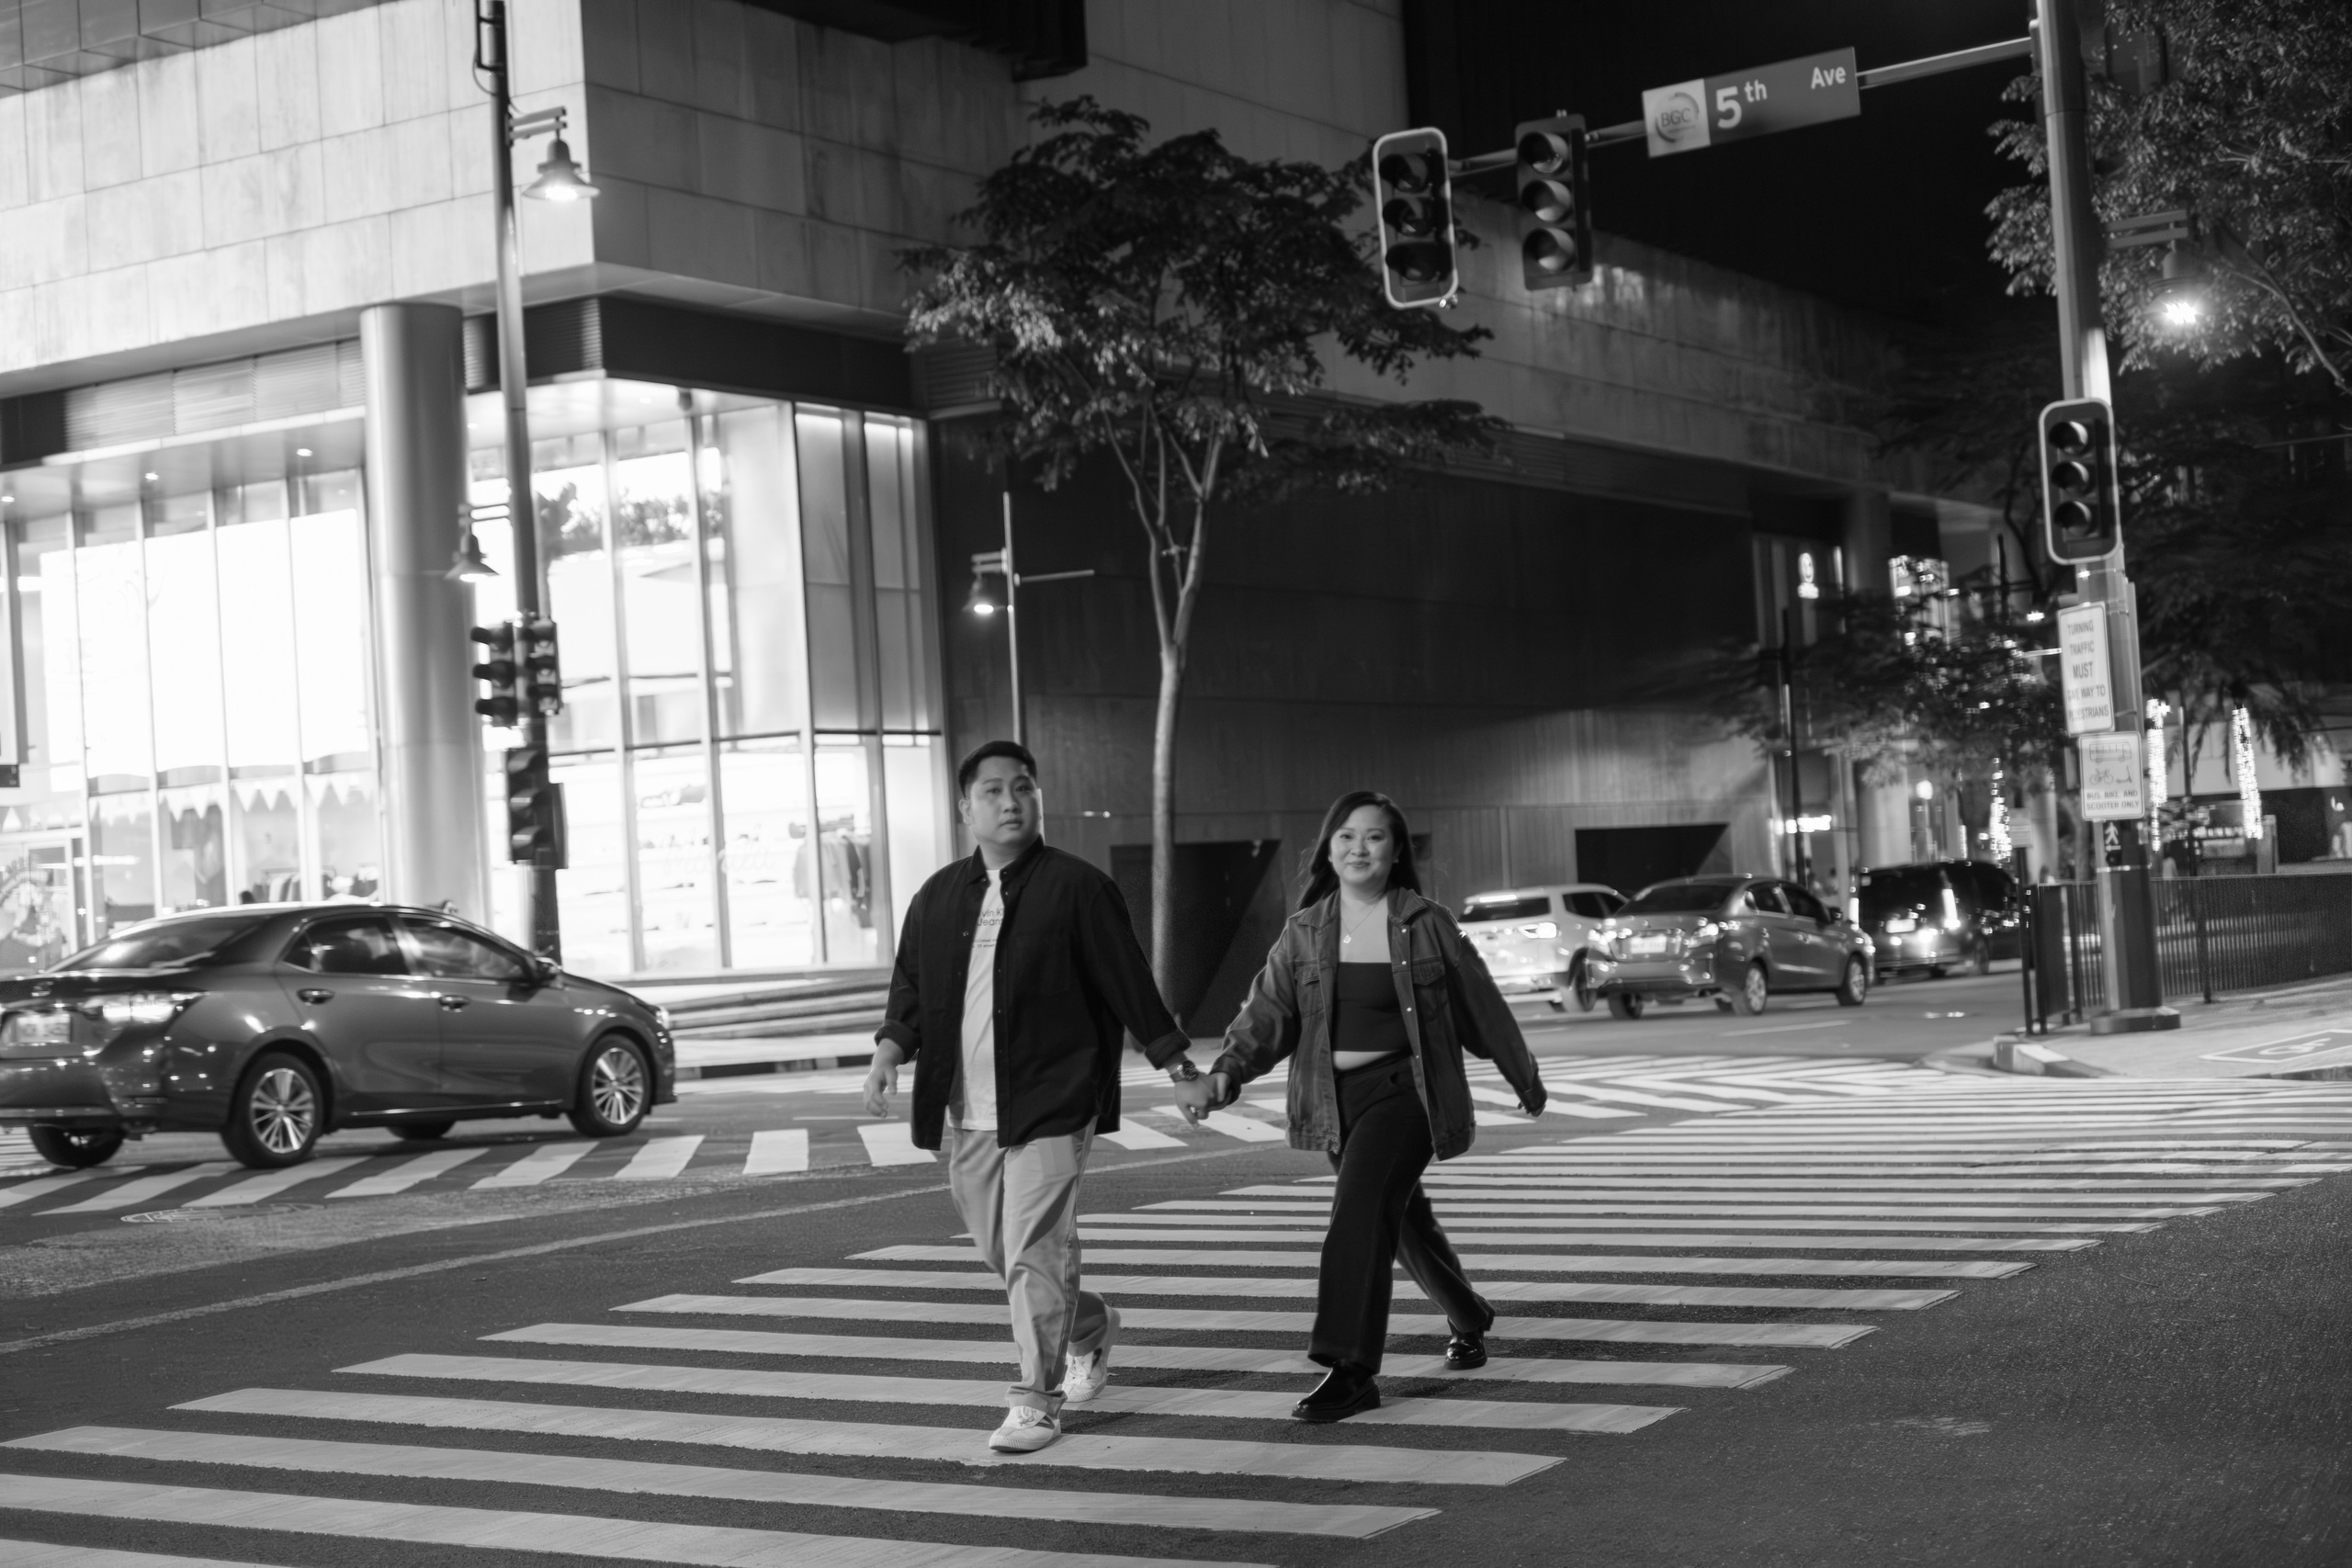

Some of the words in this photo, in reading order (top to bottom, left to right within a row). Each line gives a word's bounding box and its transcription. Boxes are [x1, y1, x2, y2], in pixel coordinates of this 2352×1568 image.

[1715, 80, 1768, 129] 5th
[1810, 66, 1847, 90] Ave
[1660, 107, 1691, 128] BGC
[2067, 619, 2095, 636] TURNING
[2069, 640, 2095, 656] TRAFFIC
[2073, 661, 2094, 679] MUST
[2080, 686, 2095, 699] WAY
[2096, 684, 2106, 697] TO
[2123, 789, 2139, 798] AND
[2086, 801, 2119, 810] SCOOTER
[2121, 800, 2140, 808] ONLY
